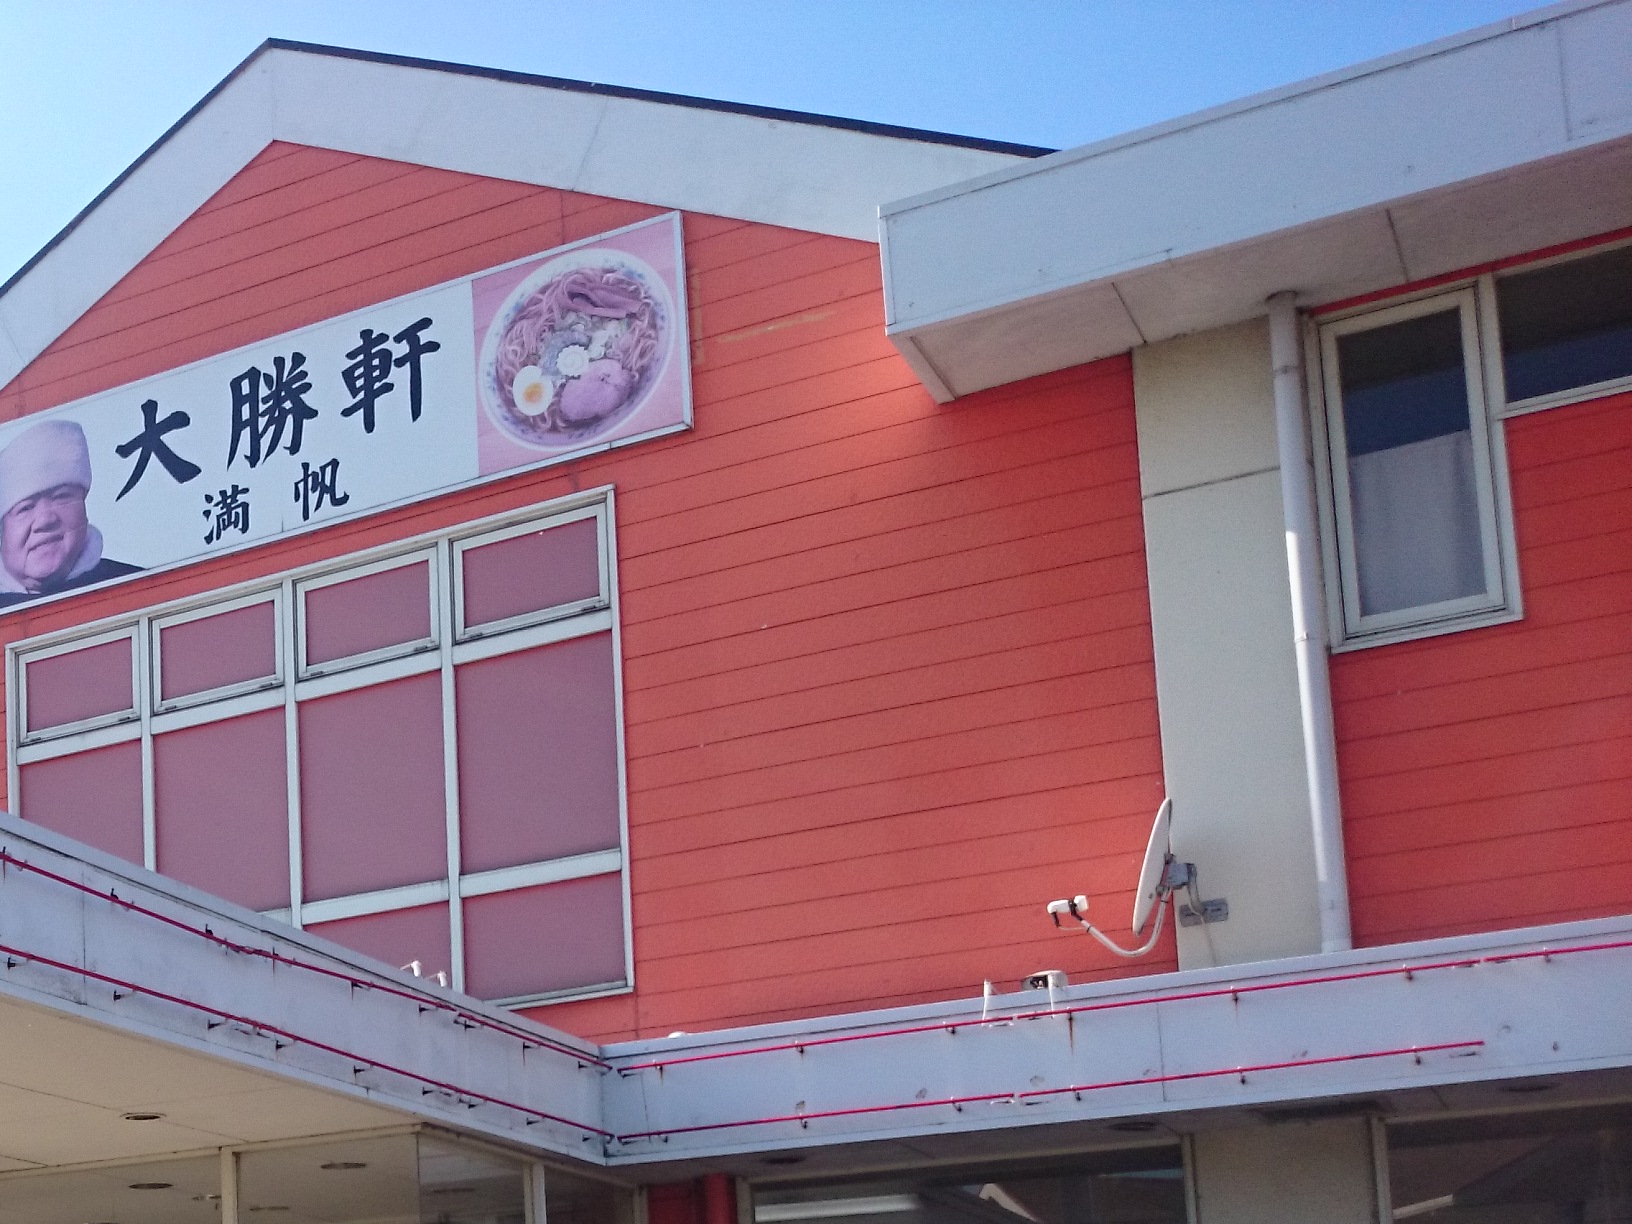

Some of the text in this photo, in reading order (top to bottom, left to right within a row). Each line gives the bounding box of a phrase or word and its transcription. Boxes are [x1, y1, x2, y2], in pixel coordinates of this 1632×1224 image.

[114, 316, 441, 502] 大勝軒
[202, 457, 350, 546] 満帆
